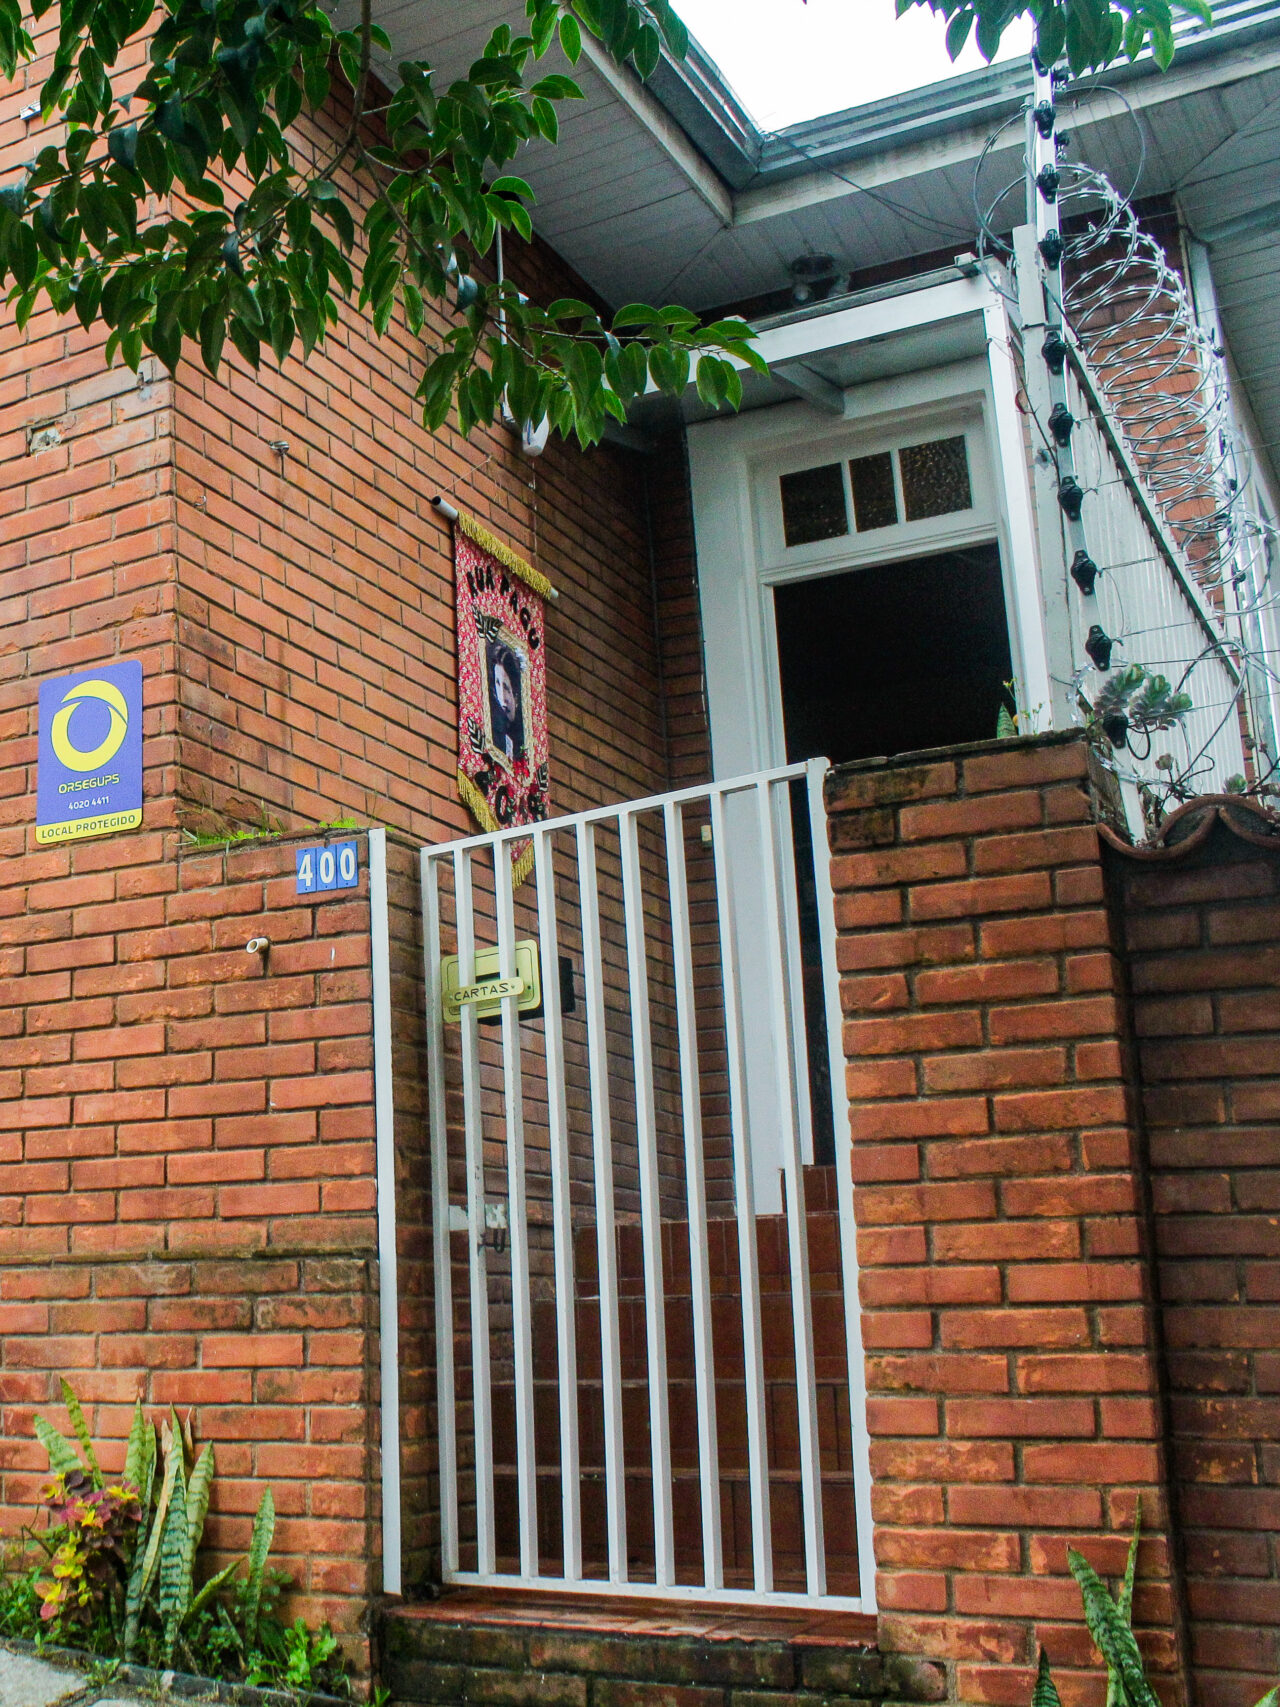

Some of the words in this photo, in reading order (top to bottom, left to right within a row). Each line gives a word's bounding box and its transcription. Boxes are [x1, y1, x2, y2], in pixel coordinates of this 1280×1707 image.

[58, 773, 120, 794] ORSEGUPS
[68, 800, 90, 810] 4020
[91, 796, 110, 806] 4411
[41, 826, 73, 839] LOCAL
[75, 814, 136, 832] PROTEGIDO
[298, 848, 355, 887] 400
[453, 982, 509, 1002] CARTAS
